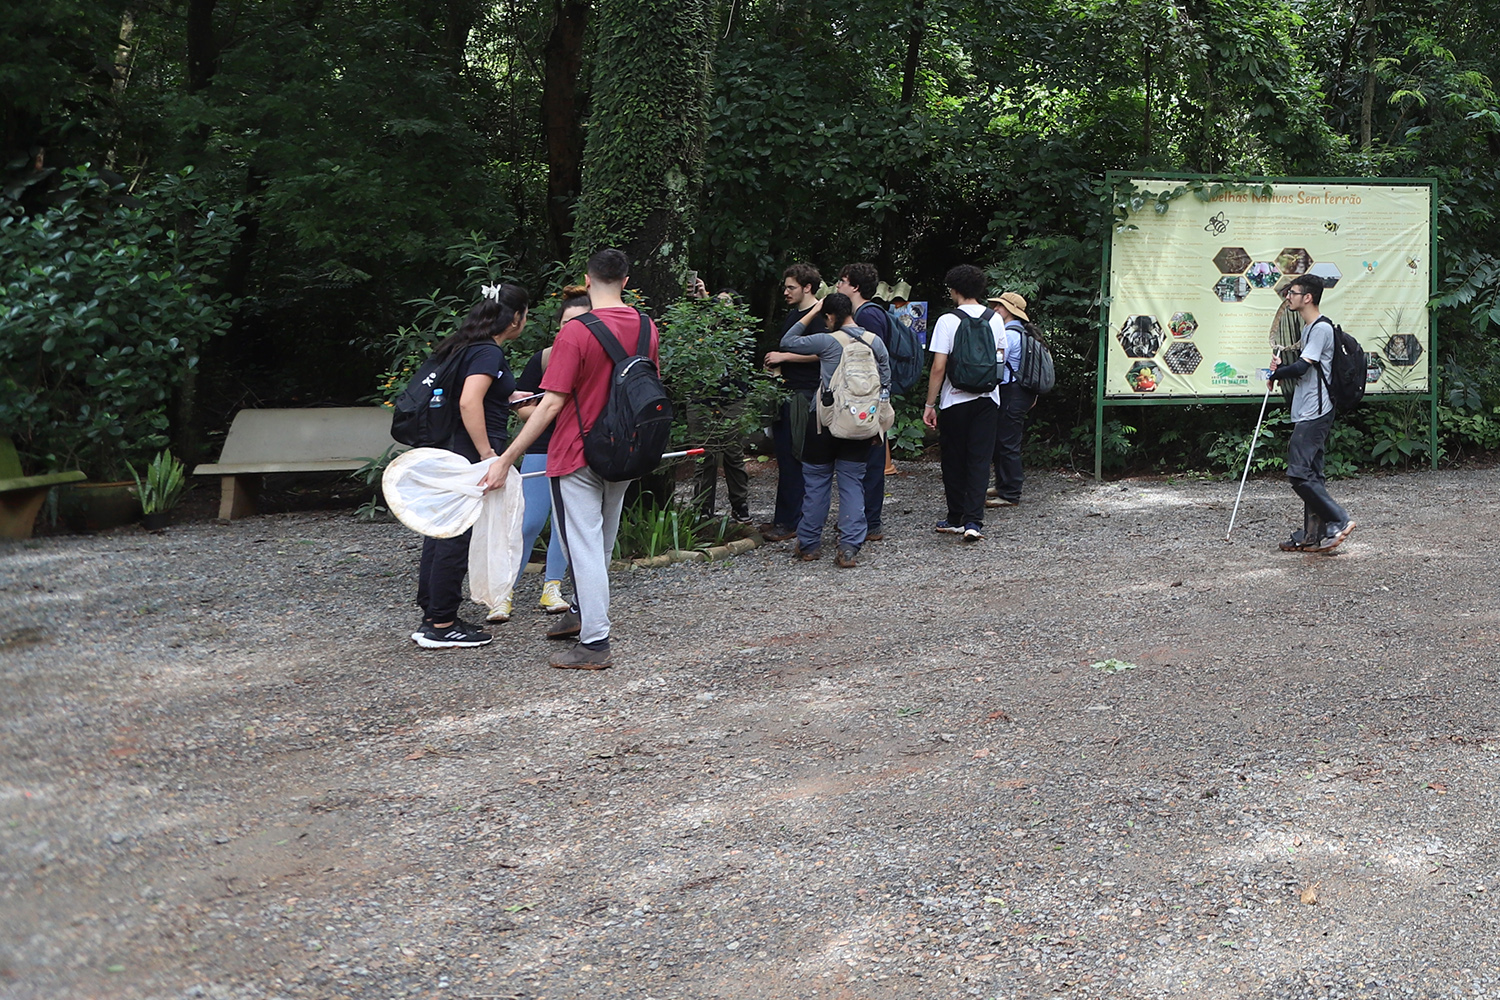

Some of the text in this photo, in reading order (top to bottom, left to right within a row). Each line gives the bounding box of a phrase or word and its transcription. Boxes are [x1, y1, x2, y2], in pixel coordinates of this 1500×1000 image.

[1207, 190, 1248, 203] belhas
[1297, 190, 1321, 205] Sem
[1325, 190, 1362, 205] Ferrão
